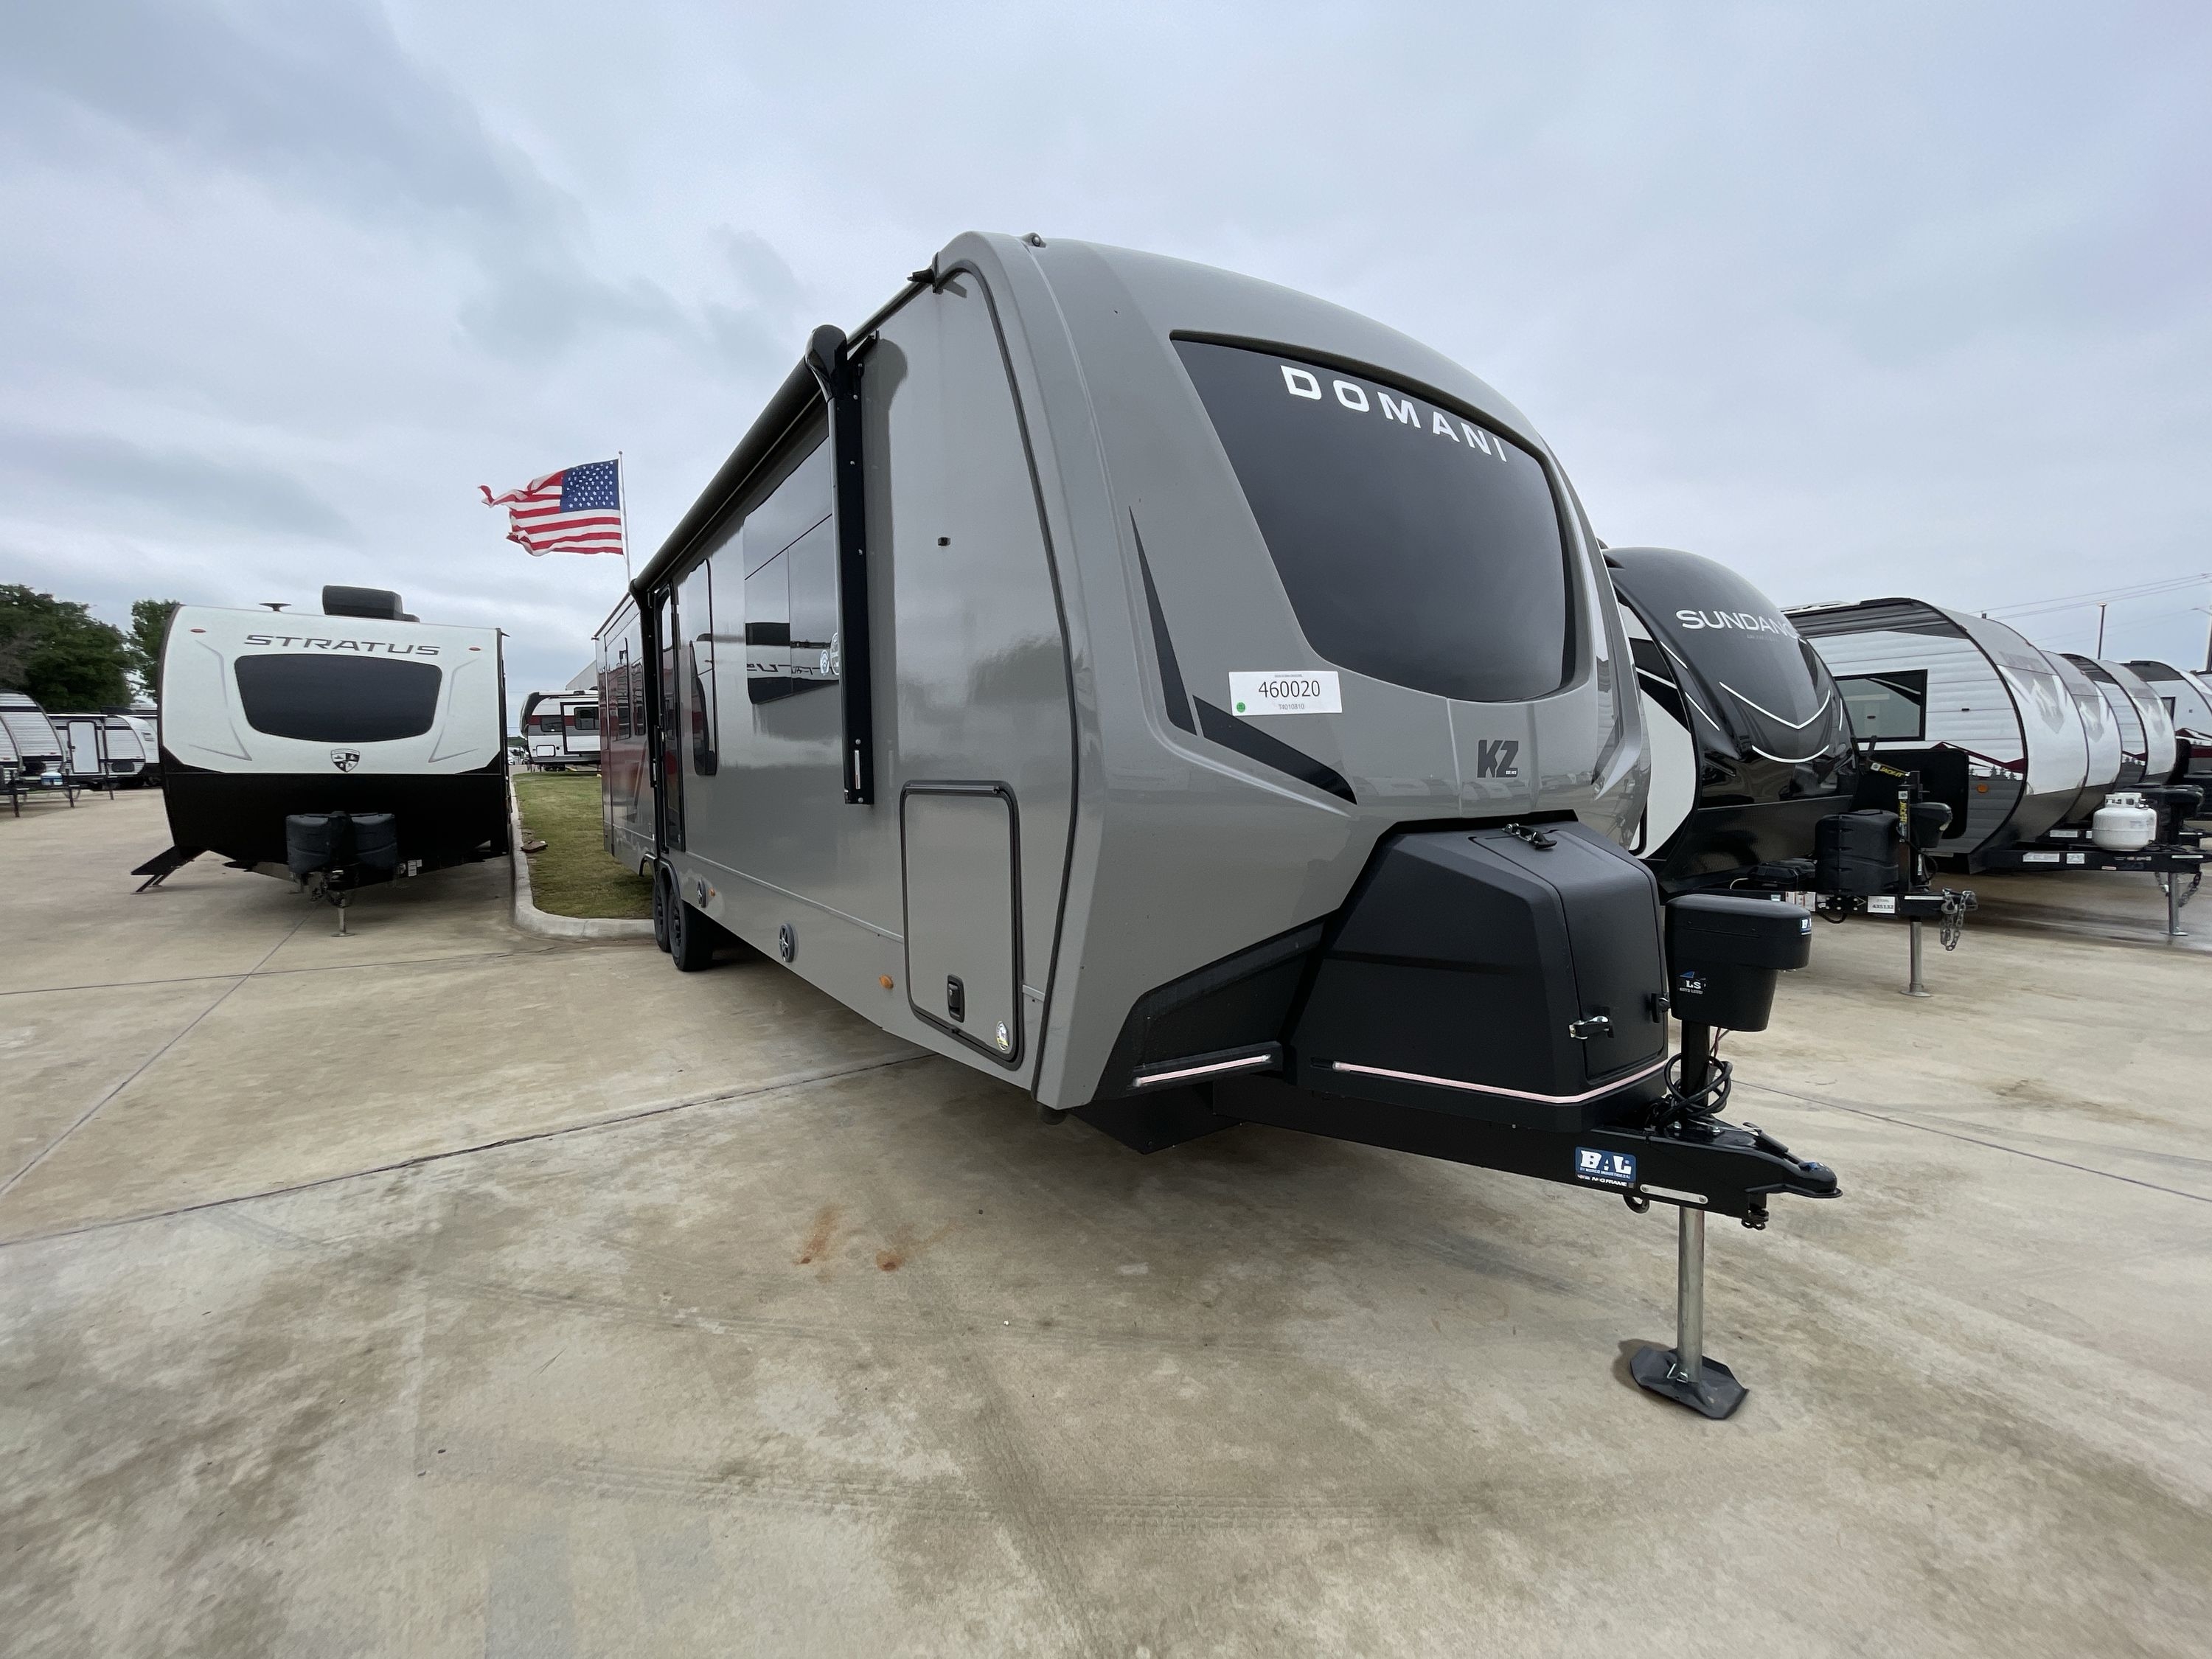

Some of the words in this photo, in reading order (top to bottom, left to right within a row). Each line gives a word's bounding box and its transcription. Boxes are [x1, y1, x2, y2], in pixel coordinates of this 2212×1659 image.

[1280, 365, 1507, 462] DOMANI
[1675, 609, 1800, 639] SUNDANC
[244, 634, 441, 655] STRATUS
[1258, 680, 1321, 698] 460020
[1477, 740, 1519, 778] KZ
[1580, 1150, 1632, 1175] BAL
